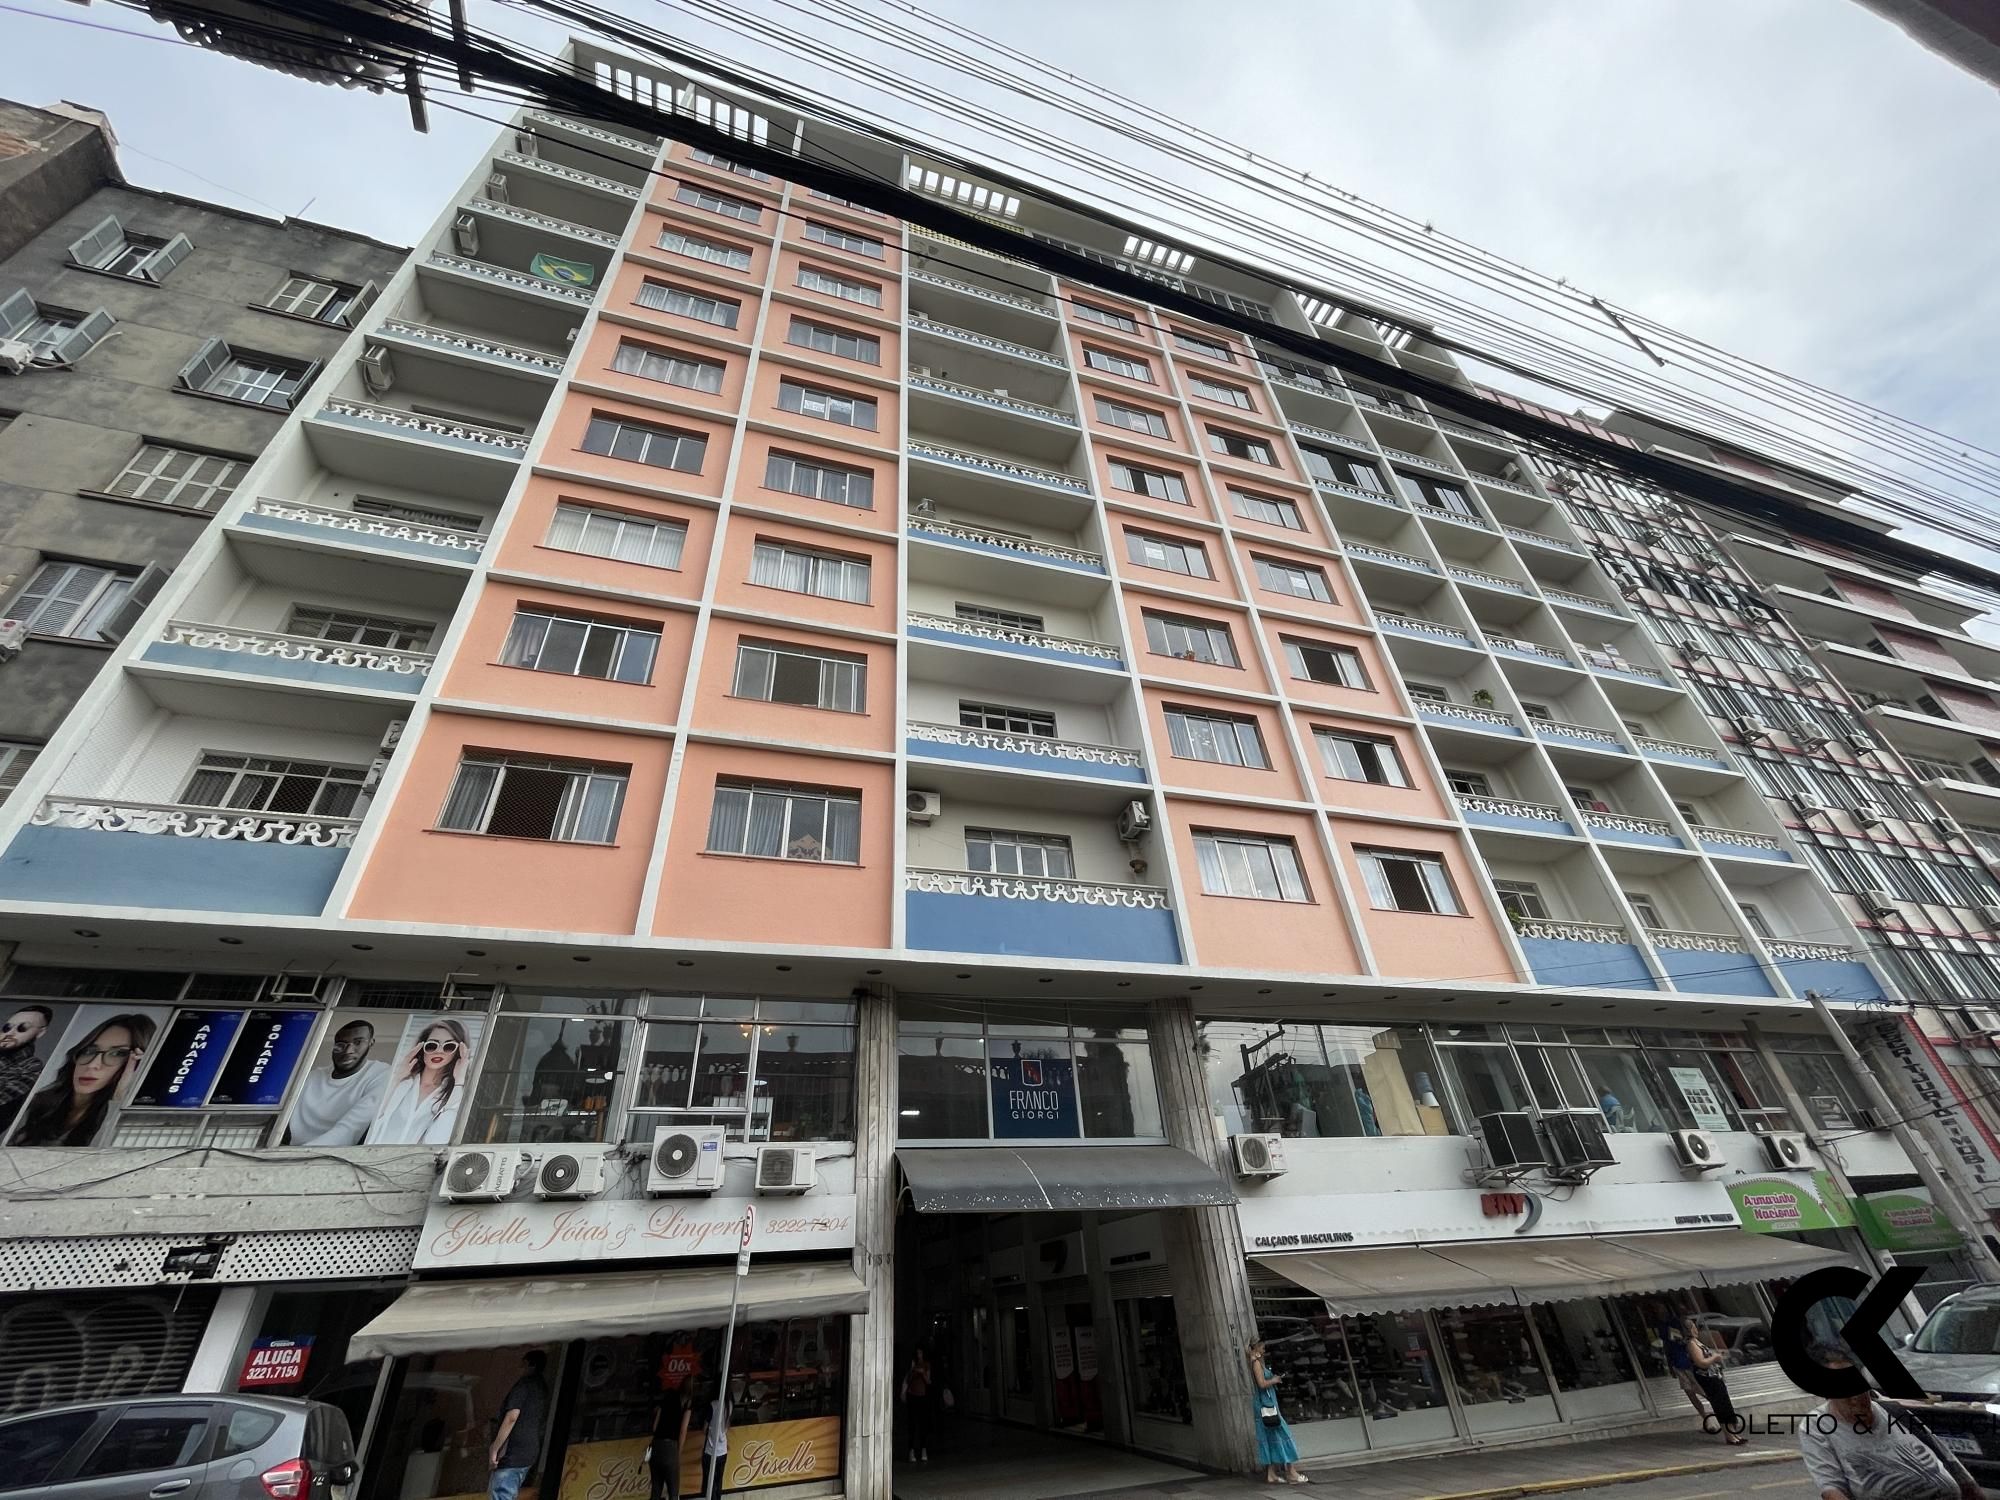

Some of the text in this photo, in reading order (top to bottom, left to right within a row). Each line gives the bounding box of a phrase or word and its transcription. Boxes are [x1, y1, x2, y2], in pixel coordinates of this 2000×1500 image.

[248, 1024, 282, 1083] SOLARES
[1009, 1090, 1059, 1111] FRANCO
[1011, 1110, 1059, 1119] GIORGI
[1743, 1192, 1797, 1207] Armarinho
[1754, 1206, 1800, 1220] Nacional
[431, 1208, 531, 1257] Giselle
[528, 1207, 612, 1251] Jóias
[607, 1223, 636, 1250] &
[641, 1204, 747, 1251] Lingeri
[1255, 1232, 1354, 1247] CALÇADOS MASCULINOS
[252, 1349, 302, 1366] ALUGA
[733, 1440, 816, 1487] Giselle
